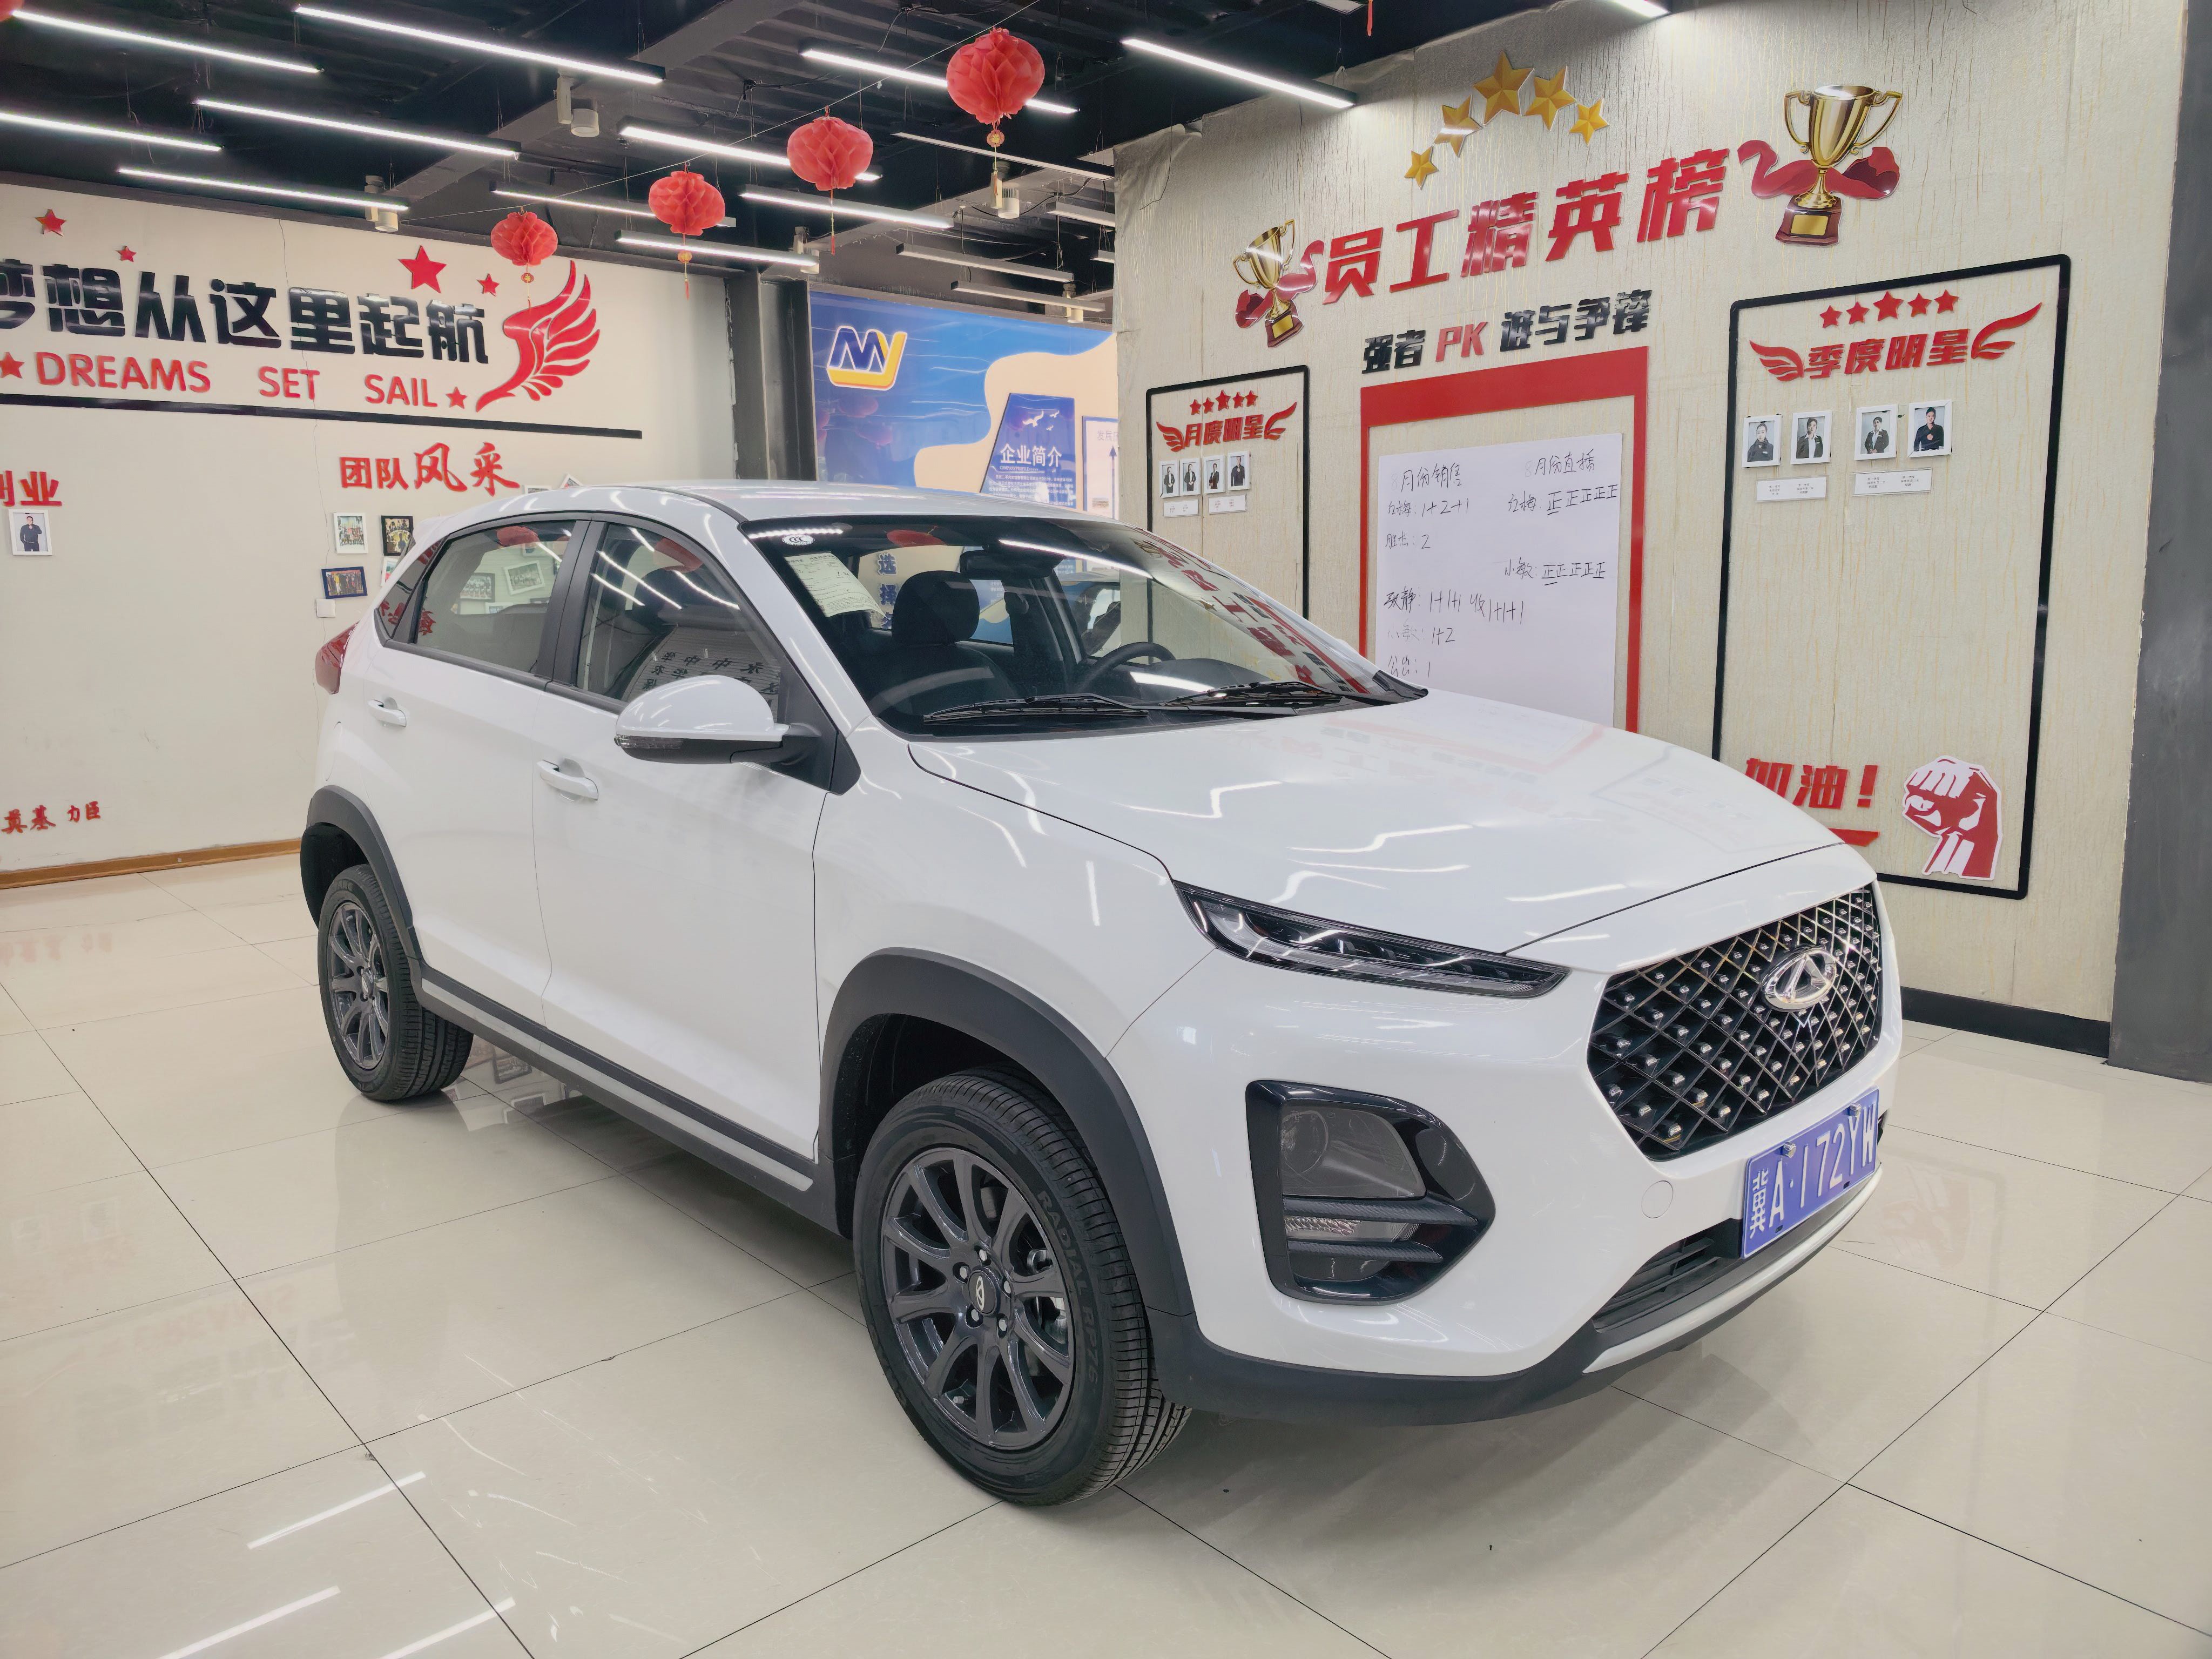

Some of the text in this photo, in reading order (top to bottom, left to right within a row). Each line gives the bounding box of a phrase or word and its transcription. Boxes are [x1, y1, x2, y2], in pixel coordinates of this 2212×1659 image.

[1323, 148, 1730, 305] 员工精英榜
[1361, 289, 1652, 374] 强者 PK 谁与争锋
[1806, 328, 1971, 379] 季度明星
[35, 352, 438, 408] DREAMS SET SAIL
[340, 441, 520, 497] 团队风采
[1000, 443, 1062, 467] 企业简介
